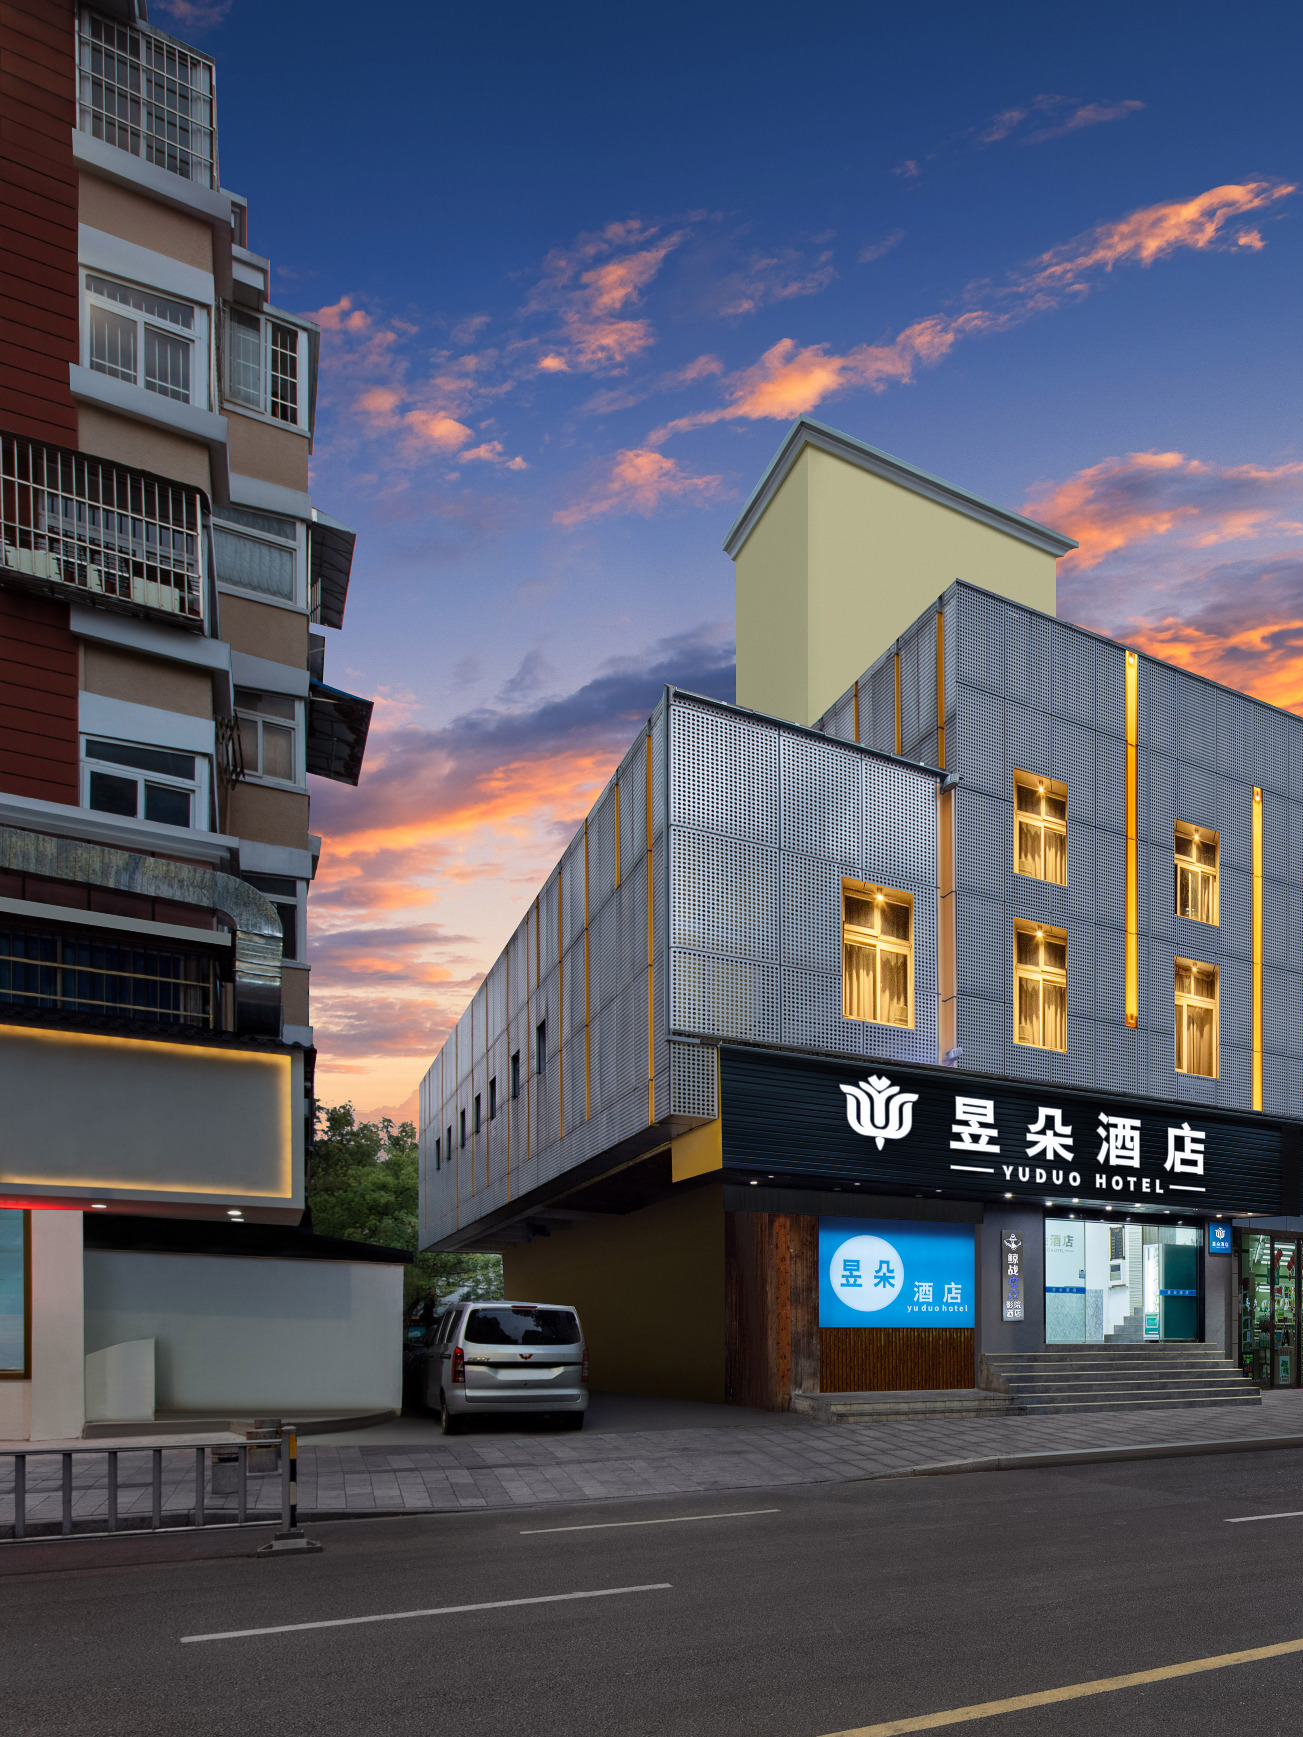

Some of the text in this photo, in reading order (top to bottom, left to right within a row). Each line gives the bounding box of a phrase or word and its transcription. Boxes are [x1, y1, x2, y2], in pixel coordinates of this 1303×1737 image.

[950, 1096, 1206, 1175] 昱朵酒店
[1002, 1165, 1164, 1194] YUDUO HOTEL
[1046, 1234, 1074, 1247] 酒店
[840, 1259, 896, 1289] 昱朵
[913, 1281, 962, 1303] 酒店
[942, 1304, 968, 1312] hotel
